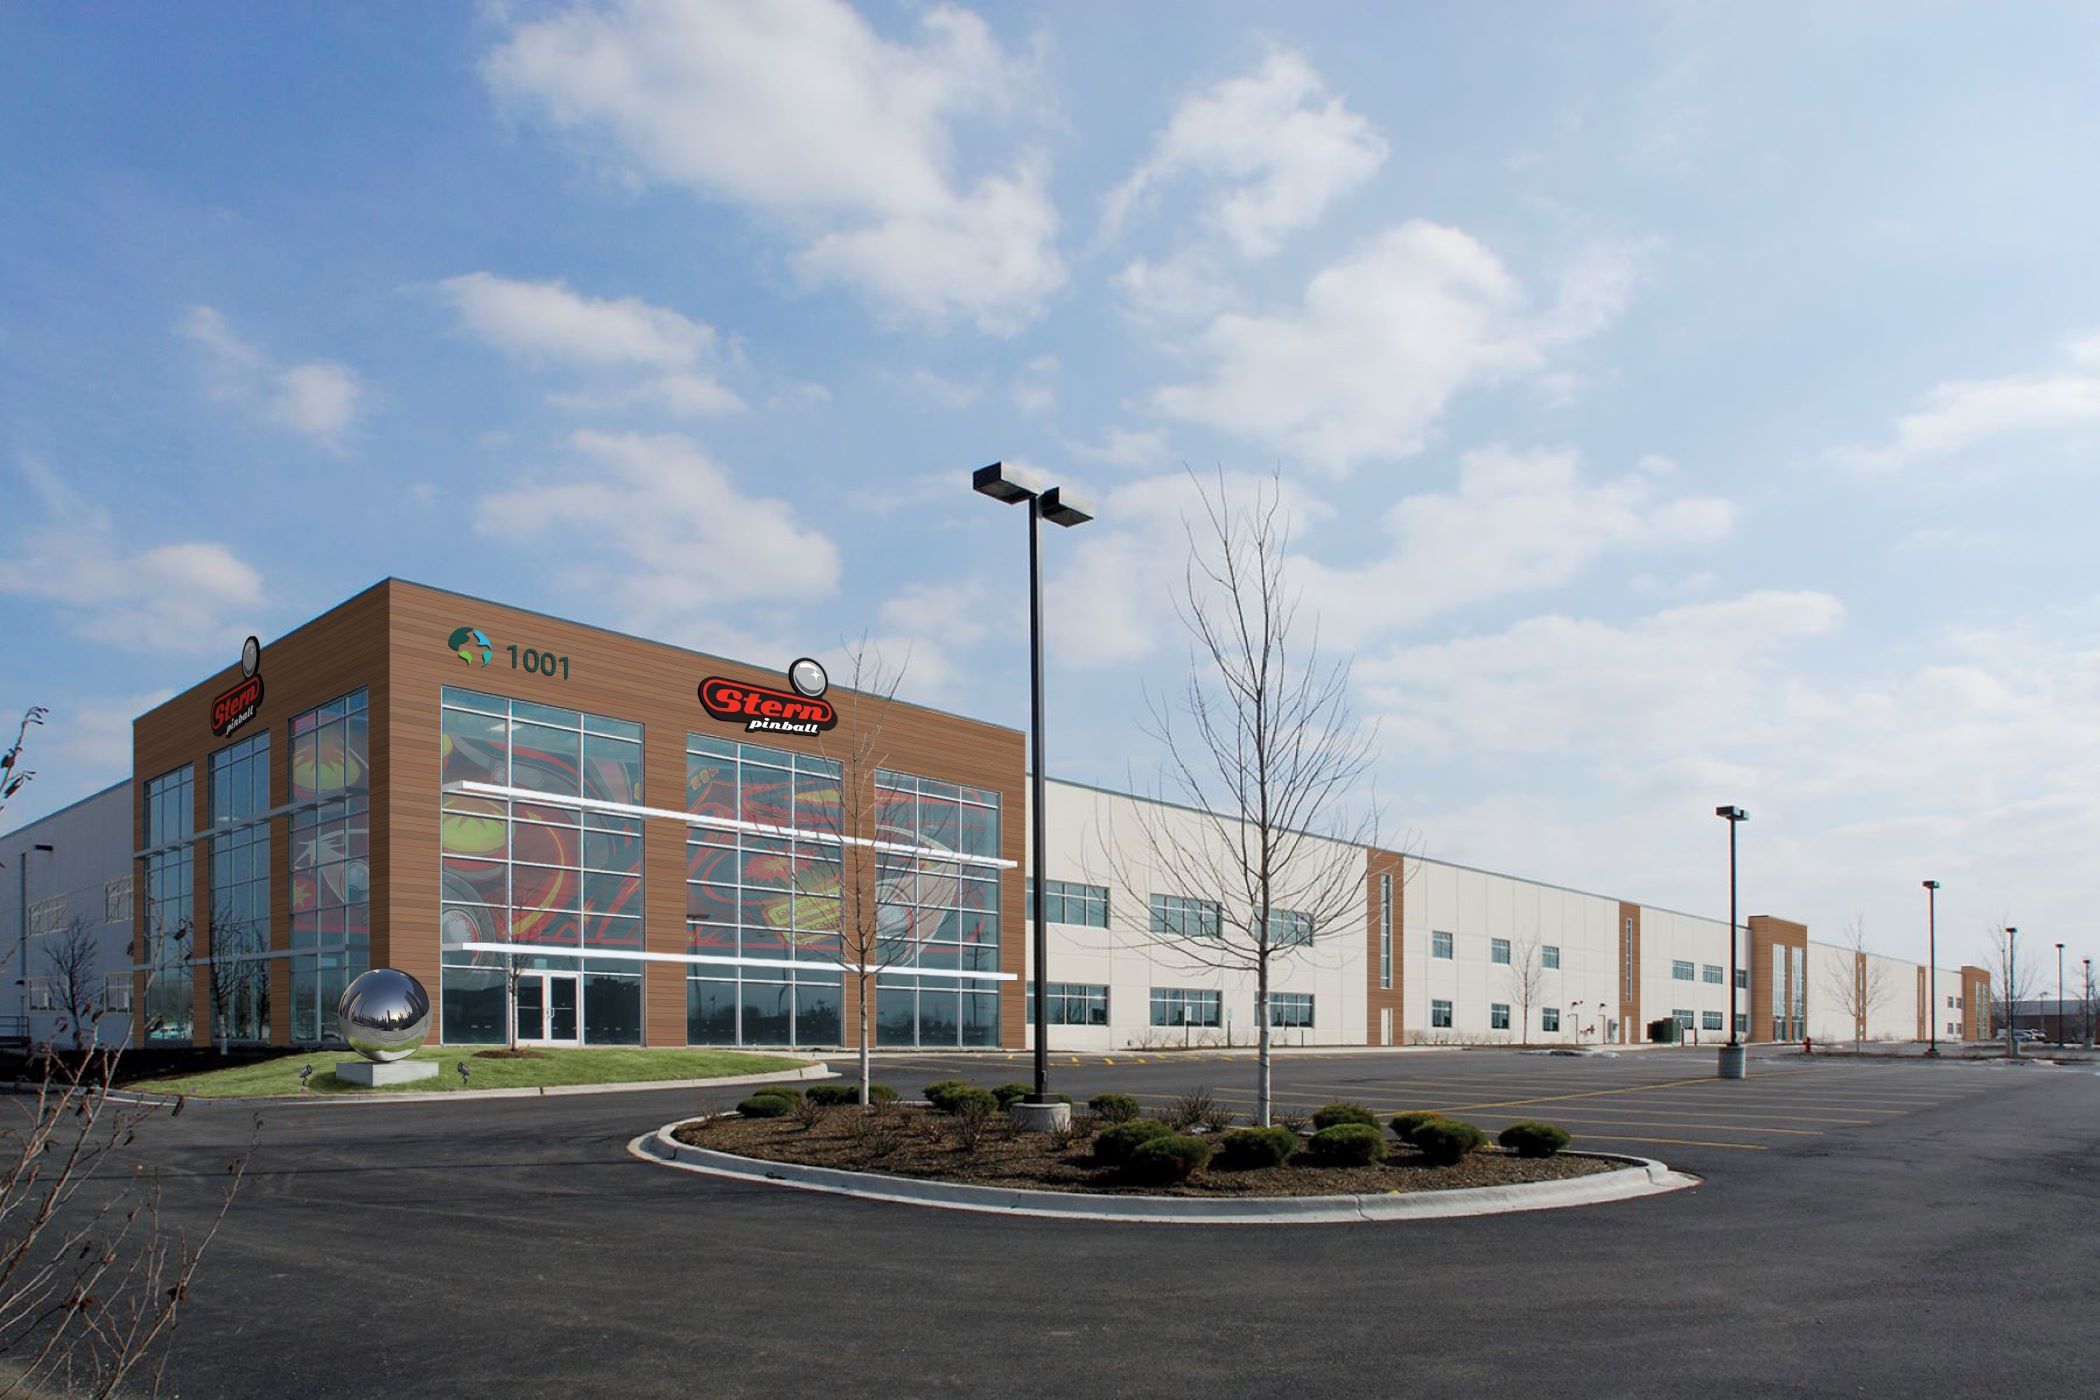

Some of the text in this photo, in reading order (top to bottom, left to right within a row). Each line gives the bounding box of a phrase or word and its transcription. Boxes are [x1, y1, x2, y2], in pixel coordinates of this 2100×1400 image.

[506, 644, 569, 680] 1001
[215, 685, 256, 726] Stern
[226, 705, 254, 735] pinball
[714, 687, 824, 721] Stern
[749, 717, 818, 734] pinball
